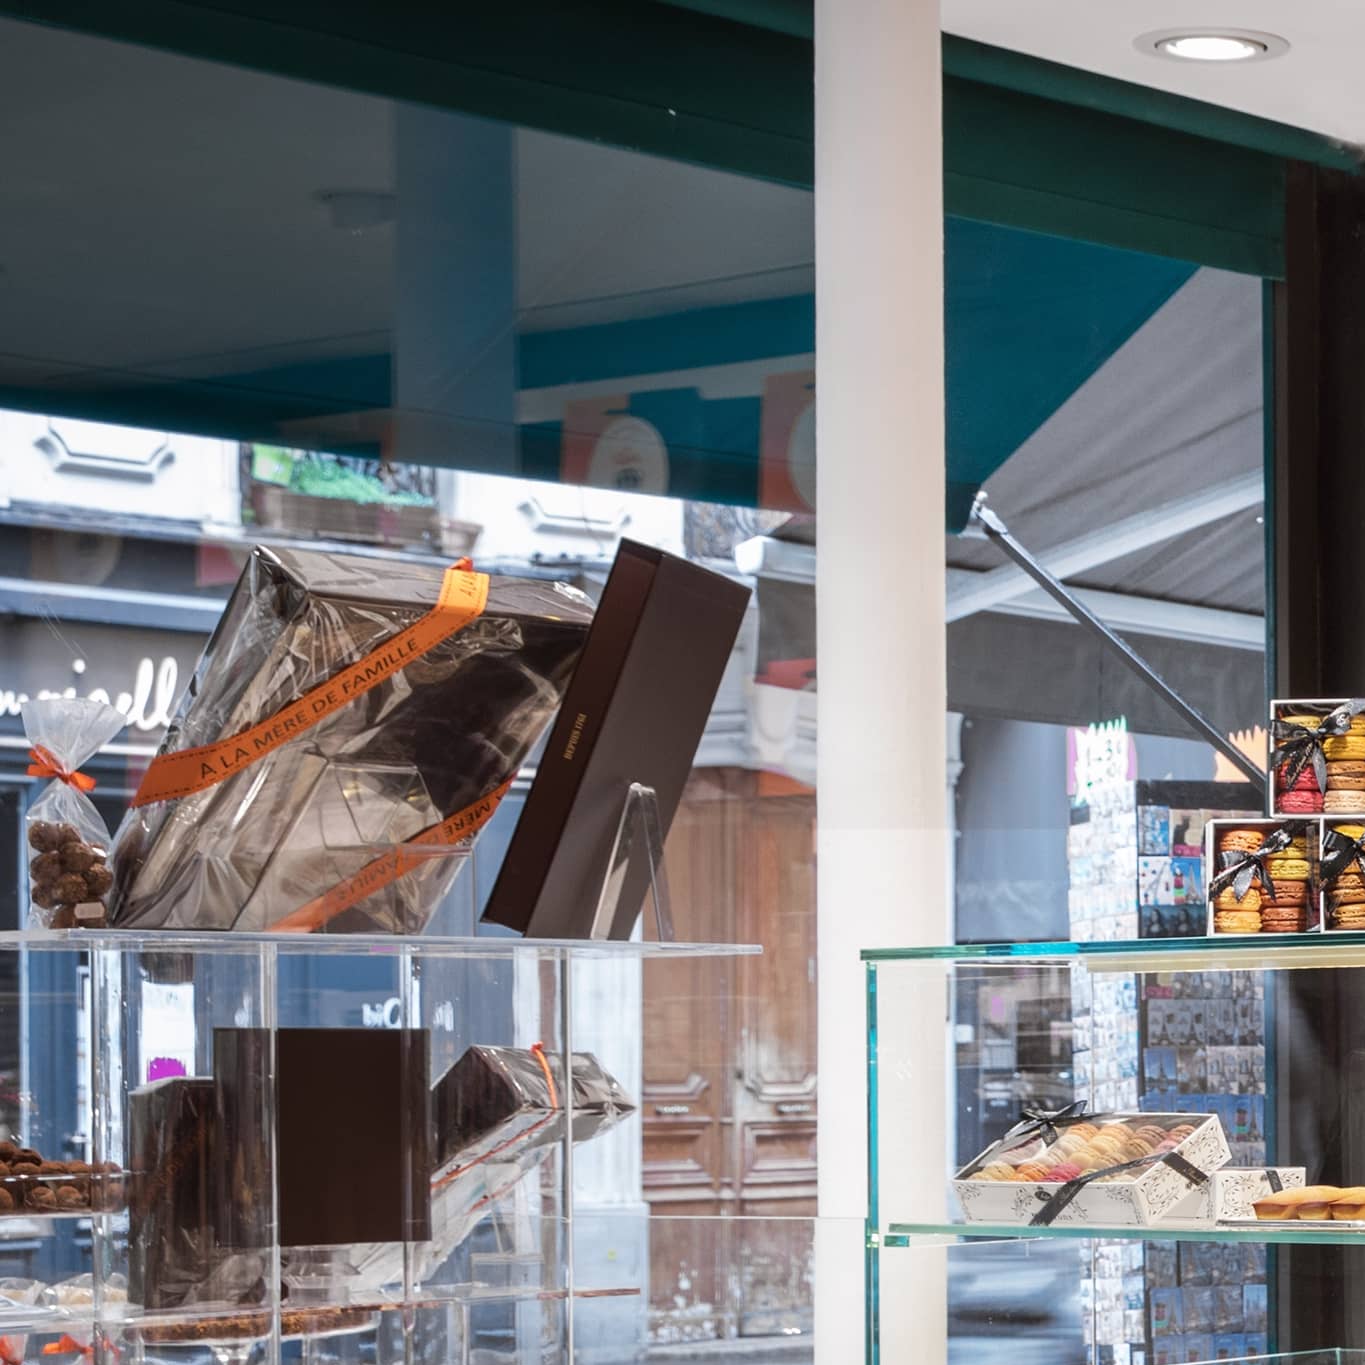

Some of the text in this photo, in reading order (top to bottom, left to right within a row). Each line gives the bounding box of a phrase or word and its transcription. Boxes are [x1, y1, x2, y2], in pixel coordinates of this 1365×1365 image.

[223, 747, 250, 769] LA
[312, 694, 338, 714] DE
[342, 638, 418, 694] FAMILLE
